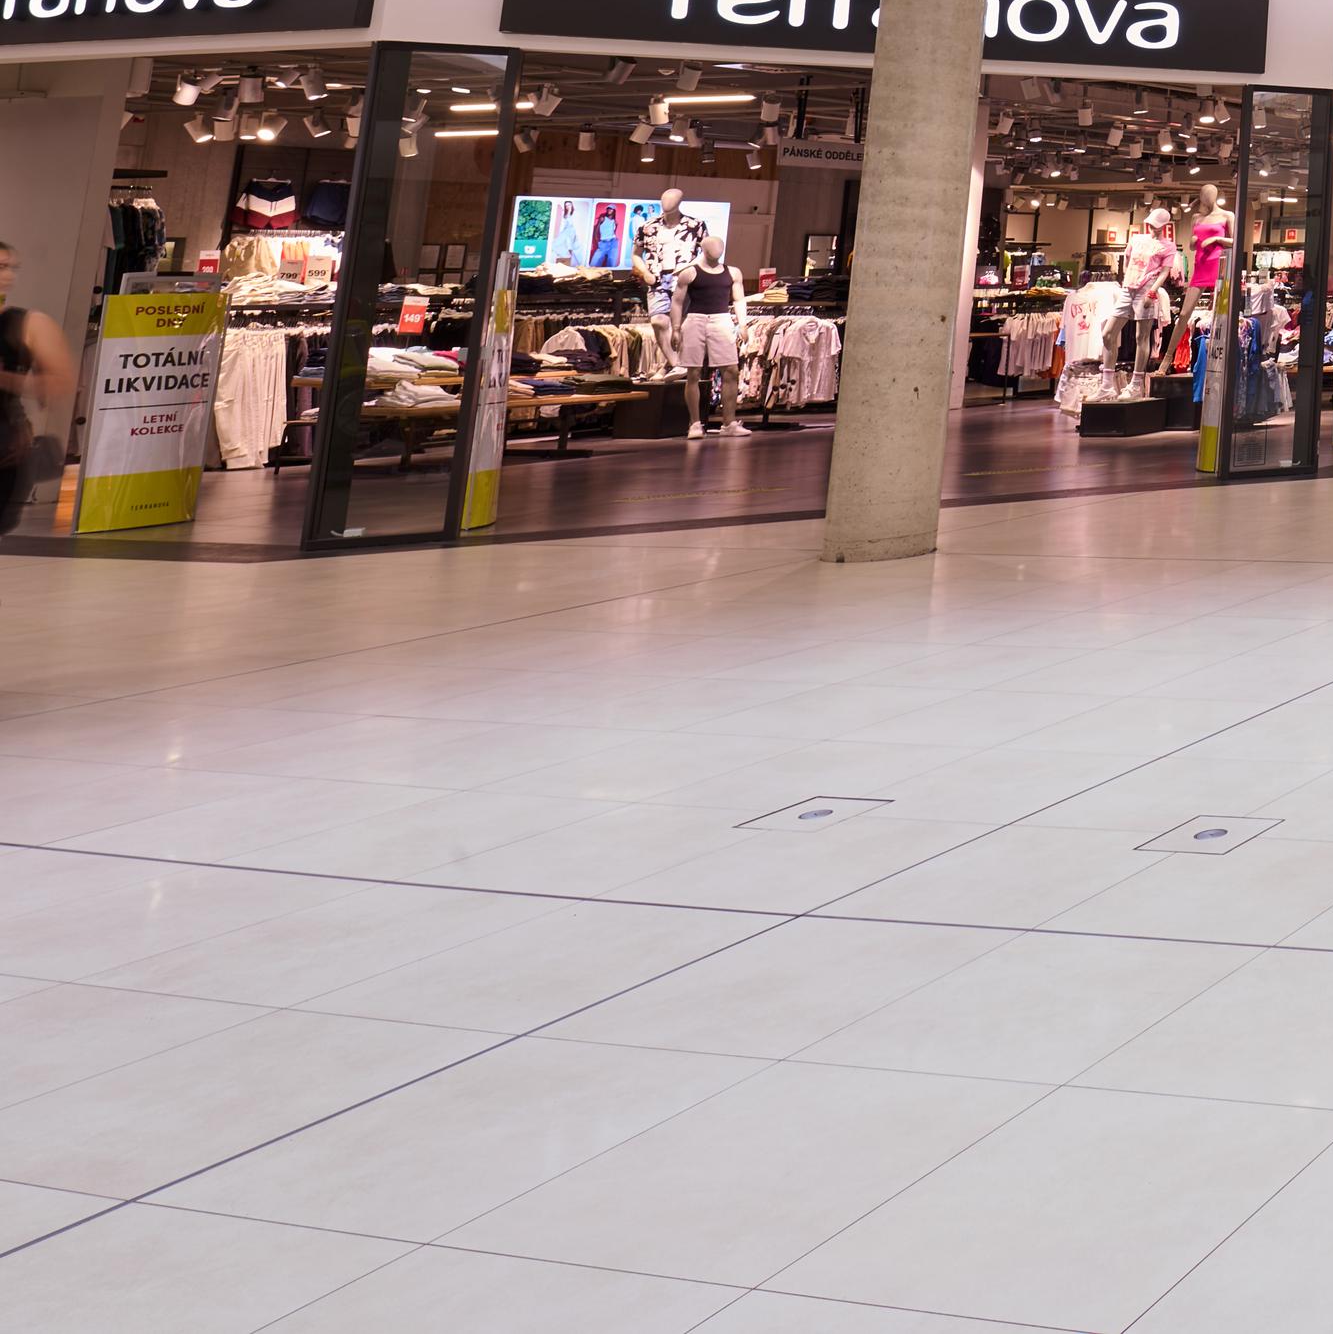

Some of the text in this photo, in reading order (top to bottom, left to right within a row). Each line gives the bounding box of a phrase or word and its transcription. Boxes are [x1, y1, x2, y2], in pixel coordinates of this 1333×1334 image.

[783, 146, 822, 159] PÁNSKÉ
[307, 269, 326, 277] 599
[136, 302, 206, 316] POSLEDNÍ
[119, 346, 207, 369] TOTÁLNÍ
[104, 373, 210, 394] LIKVIDACE
[143, 412, 178, 423] LETNÍ
[130, 424, 184, 436] KOLEKCE
